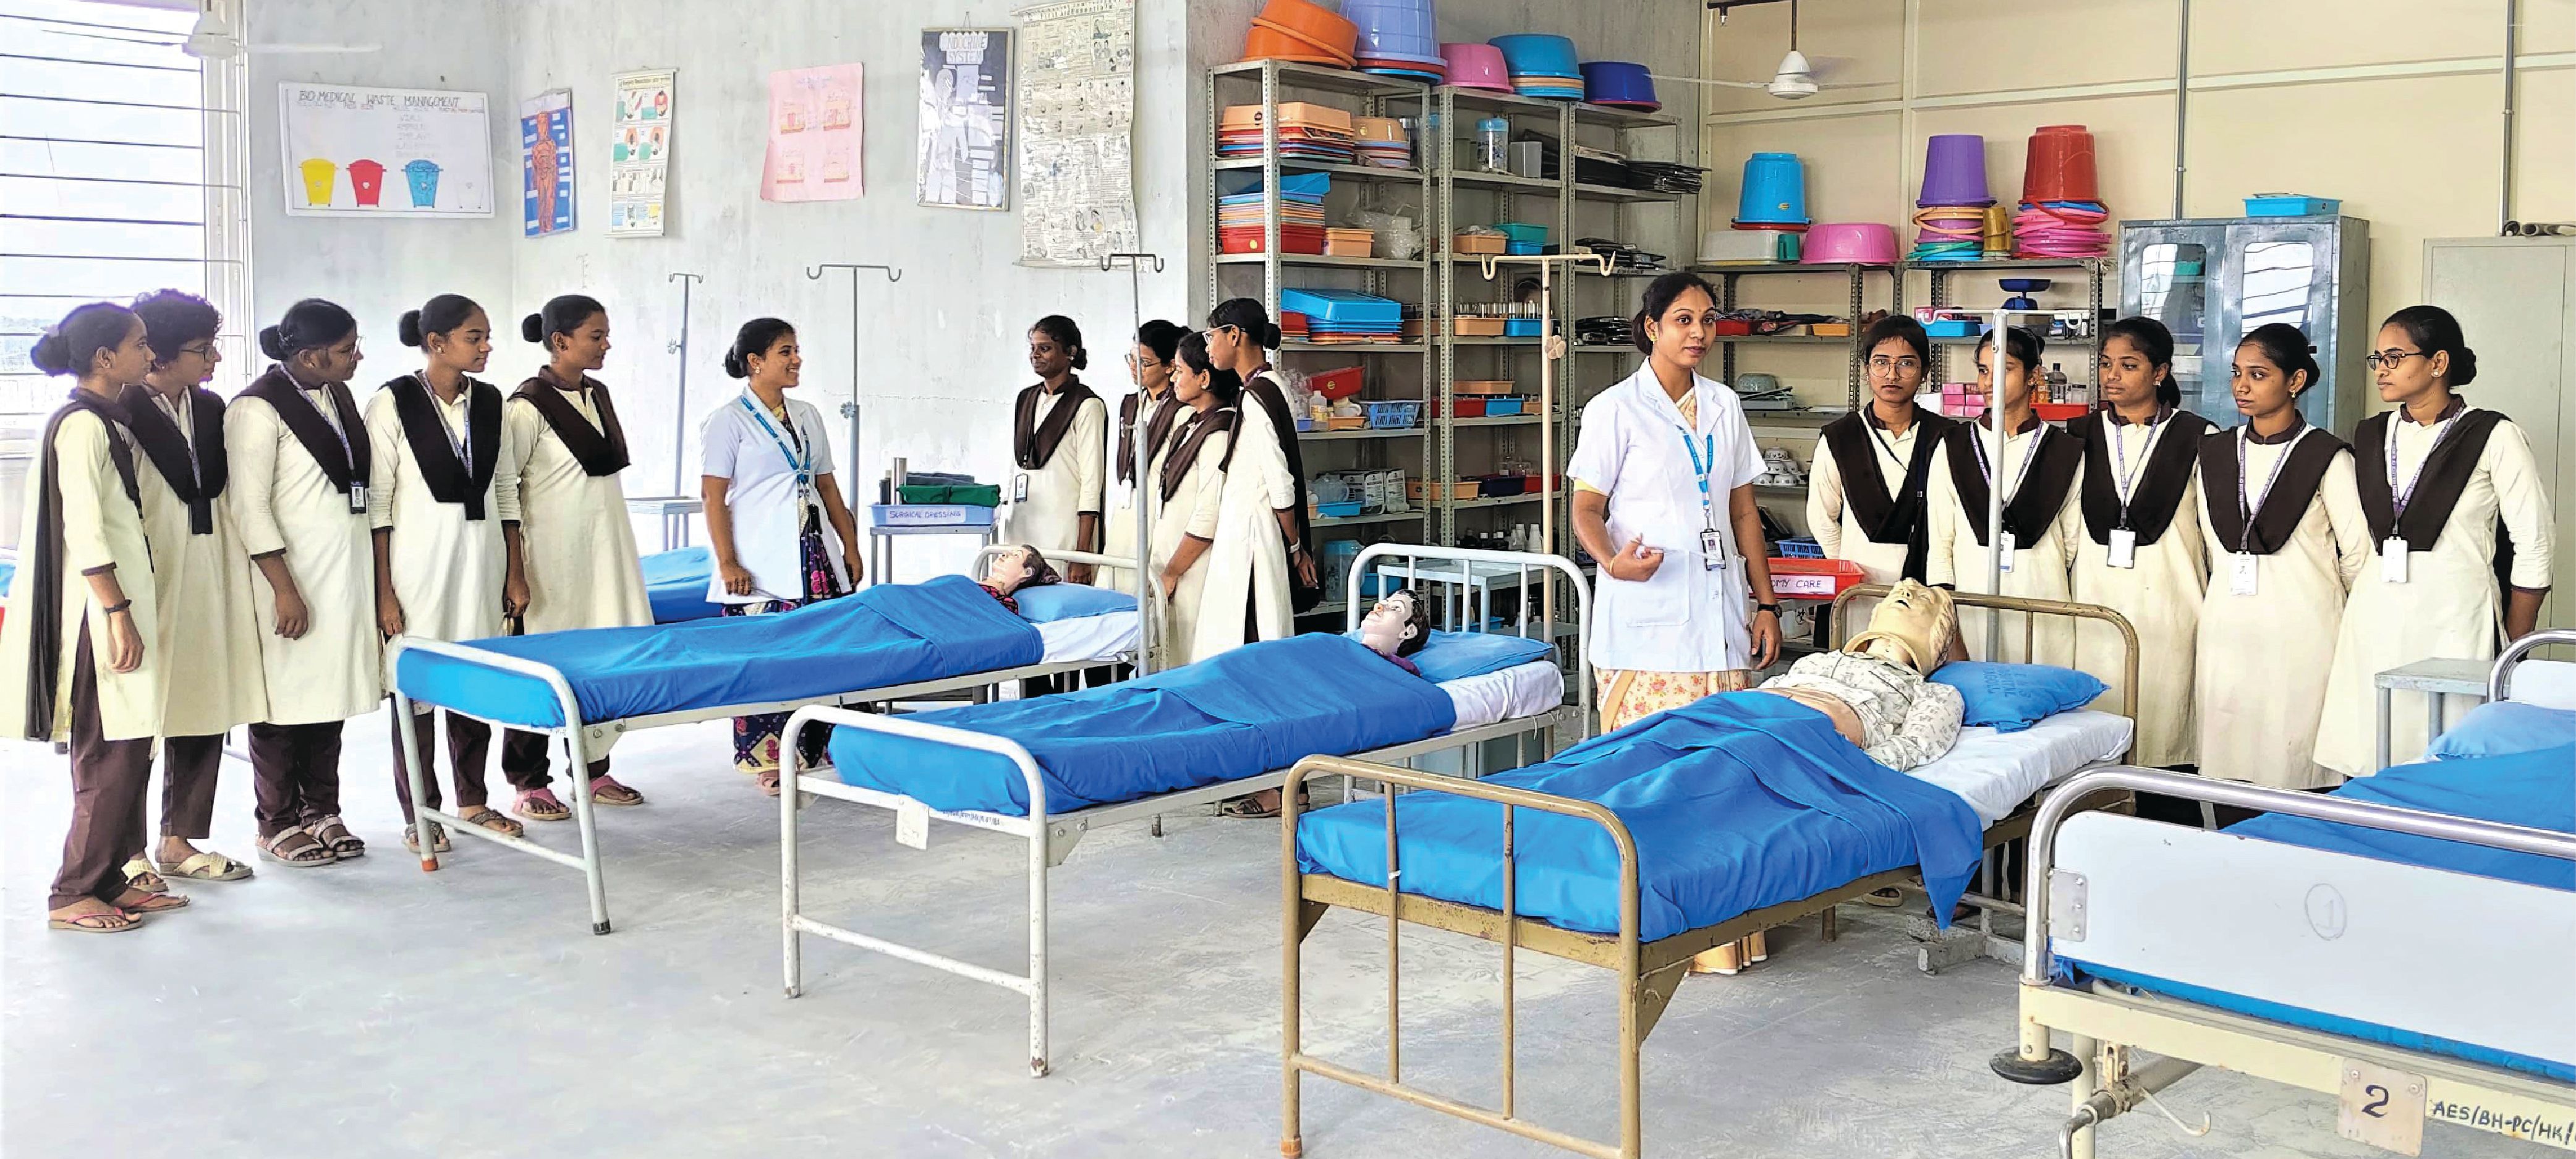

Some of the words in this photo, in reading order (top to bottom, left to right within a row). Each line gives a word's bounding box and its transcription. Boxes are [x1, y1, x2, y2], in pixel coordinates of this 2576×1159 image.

[367, 94, 396, 106] WASTE
[403, 96, 462, 108] MANAGEMENT
[925, 510, 961, 519] DRESSING
[1796, 579, 1822, 588] CARE
[2361, 1084, 2390, 1118] 2
[2432, 1100, 2576, 1146] AES/BH-PC/HK/
